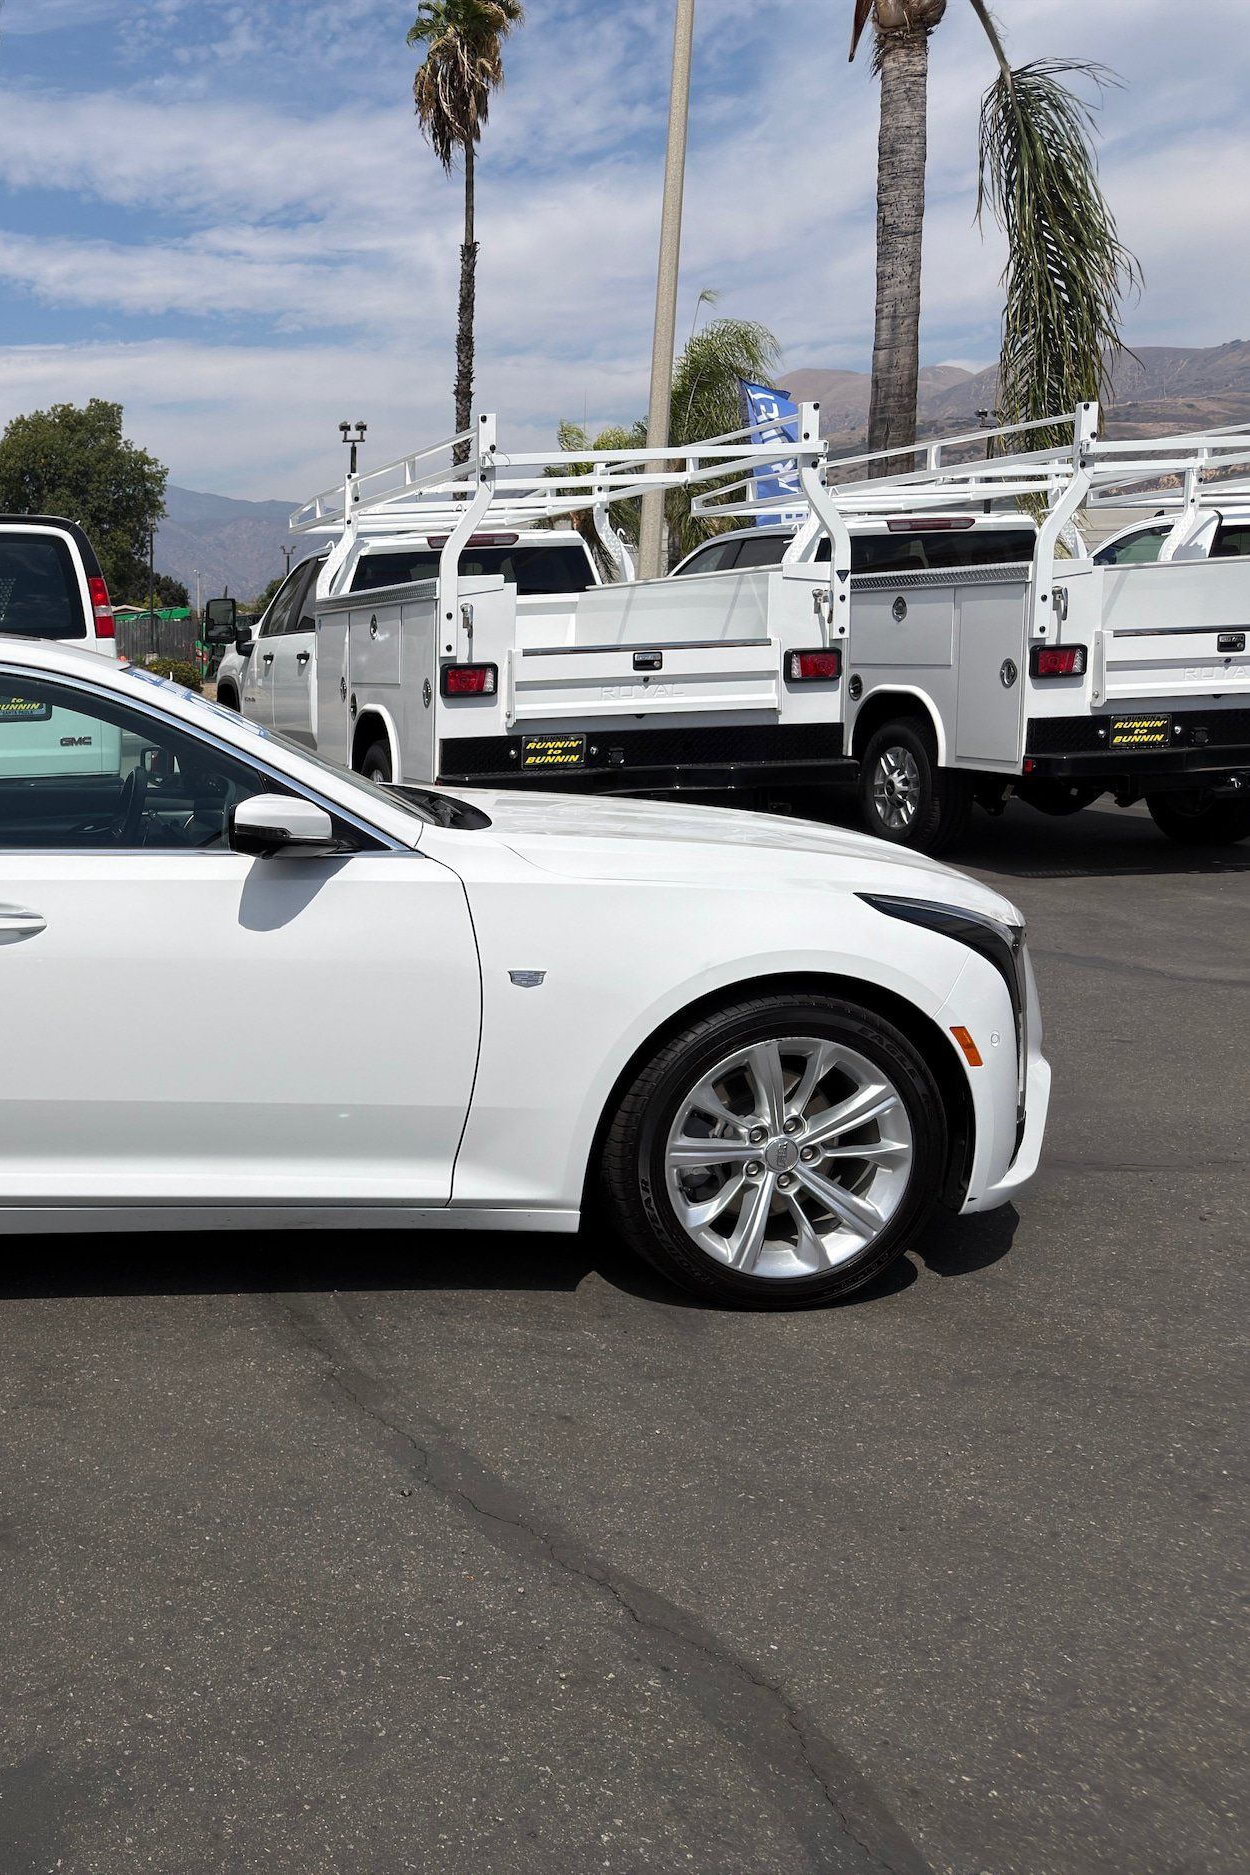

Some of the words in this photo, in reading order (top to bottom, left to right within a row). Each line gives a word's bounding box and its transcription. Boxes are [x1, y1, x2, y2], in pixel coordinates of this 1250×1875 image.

[600, 684, 685, 701] ROYAL
[60, 737, 92, 747] GMC
[1113, 734, 1165, 743] BUNNIN
[525, 755, 581, 764] BUNNIN
